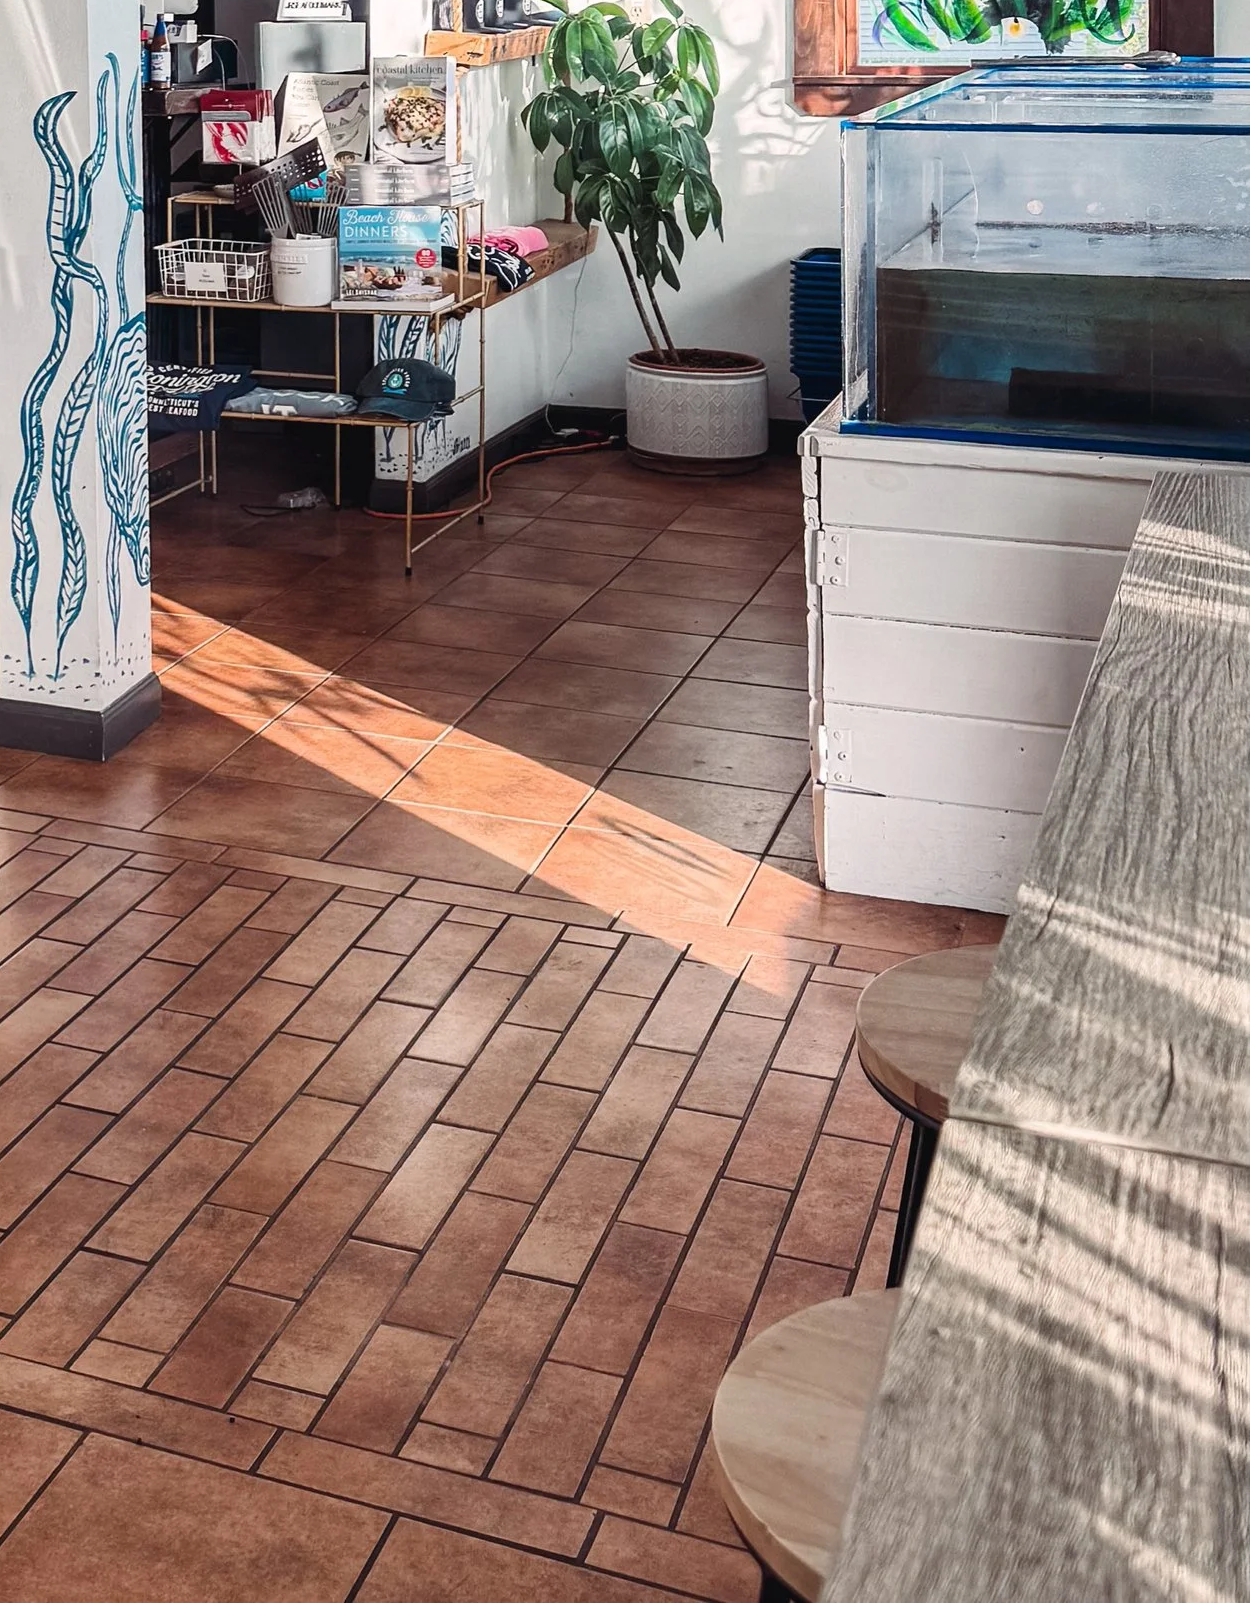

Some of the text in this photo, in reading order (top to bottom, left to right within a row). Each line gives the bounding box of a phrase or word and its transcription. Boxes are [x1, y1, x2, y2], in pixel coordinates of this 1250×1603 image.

[376, 63, 444, 75] coastal kitchen
[343, 210, 430, 225] Beach House
[344, 226, 408, 238] DINNERS
[147, 371, 241, 388] onington
[148, 404, 164, 413] EST
